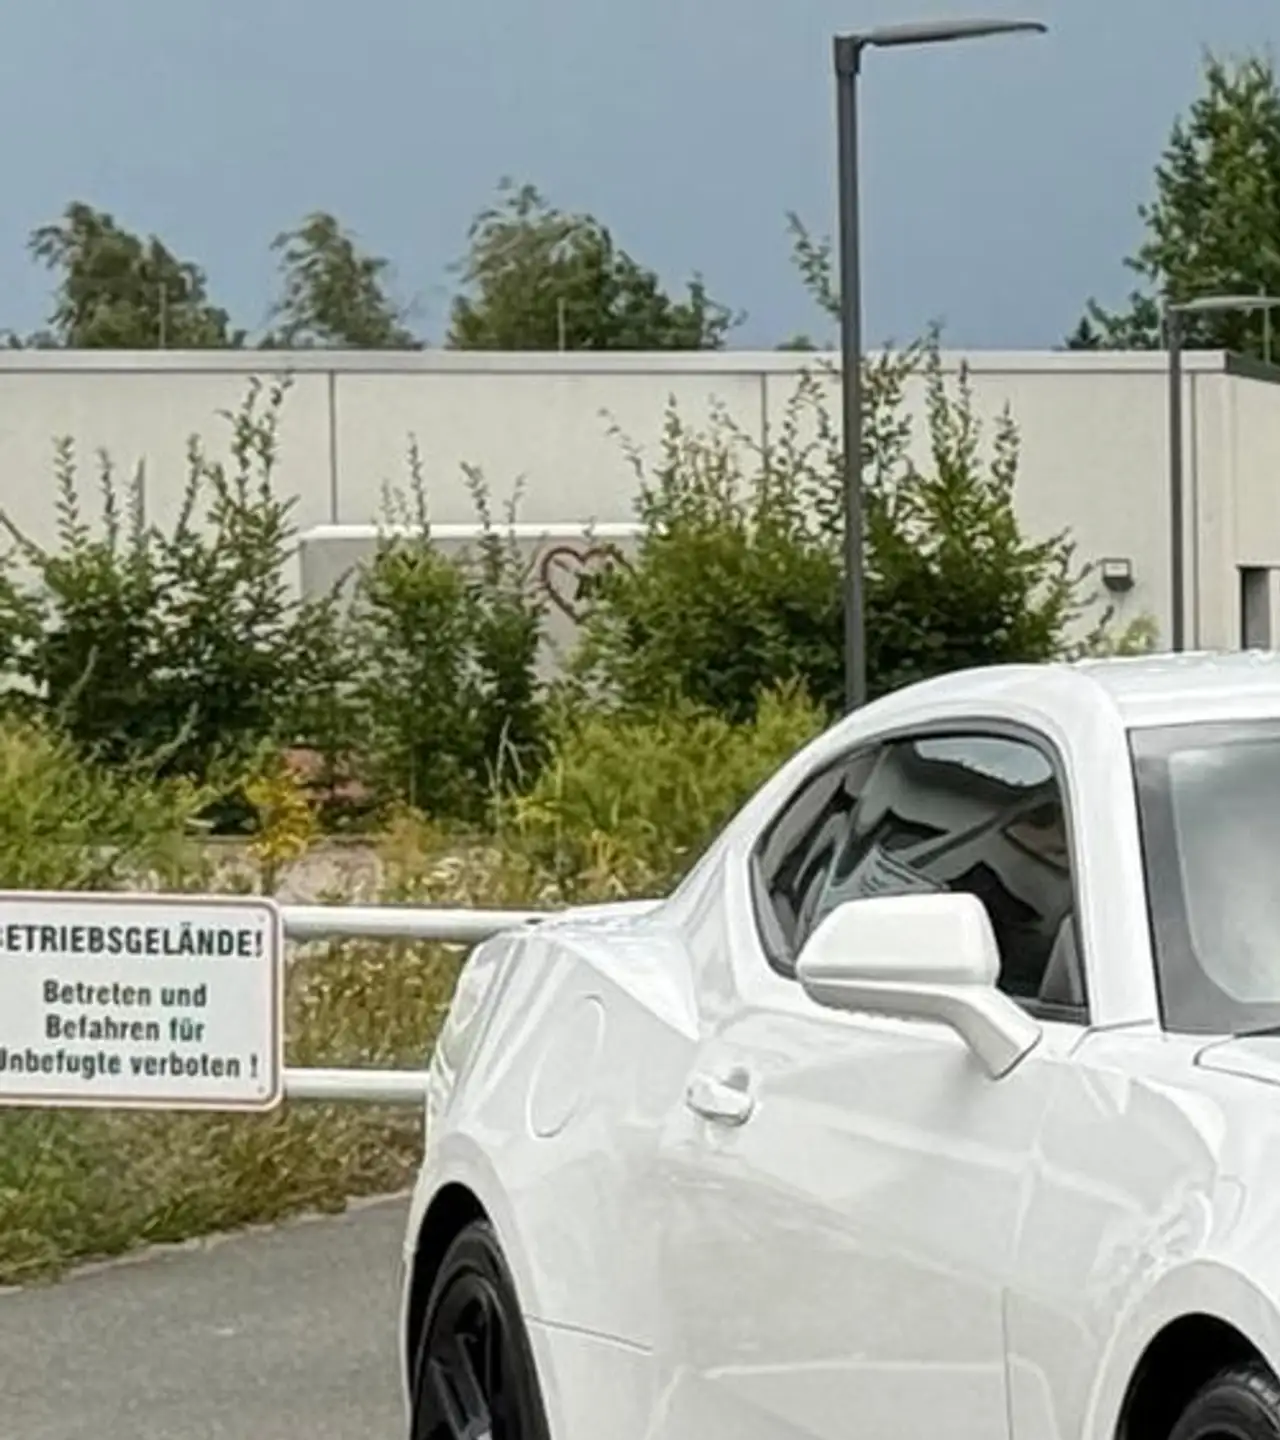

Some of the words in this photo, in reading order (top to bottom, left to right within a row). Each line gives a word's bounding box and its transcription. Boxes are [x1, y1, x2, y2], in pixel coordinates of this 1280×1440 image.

[0, 921, 263, 959] ETRIEBSGELÄNDE!
[43, 978, 151, 1007] Betreten
[161, 983, 207, 1008] und
[46, 1013, 160, 1042] Befahren
[169, 1016, 205, 1043] für
[130, 1049, 240, 1079] verboten
